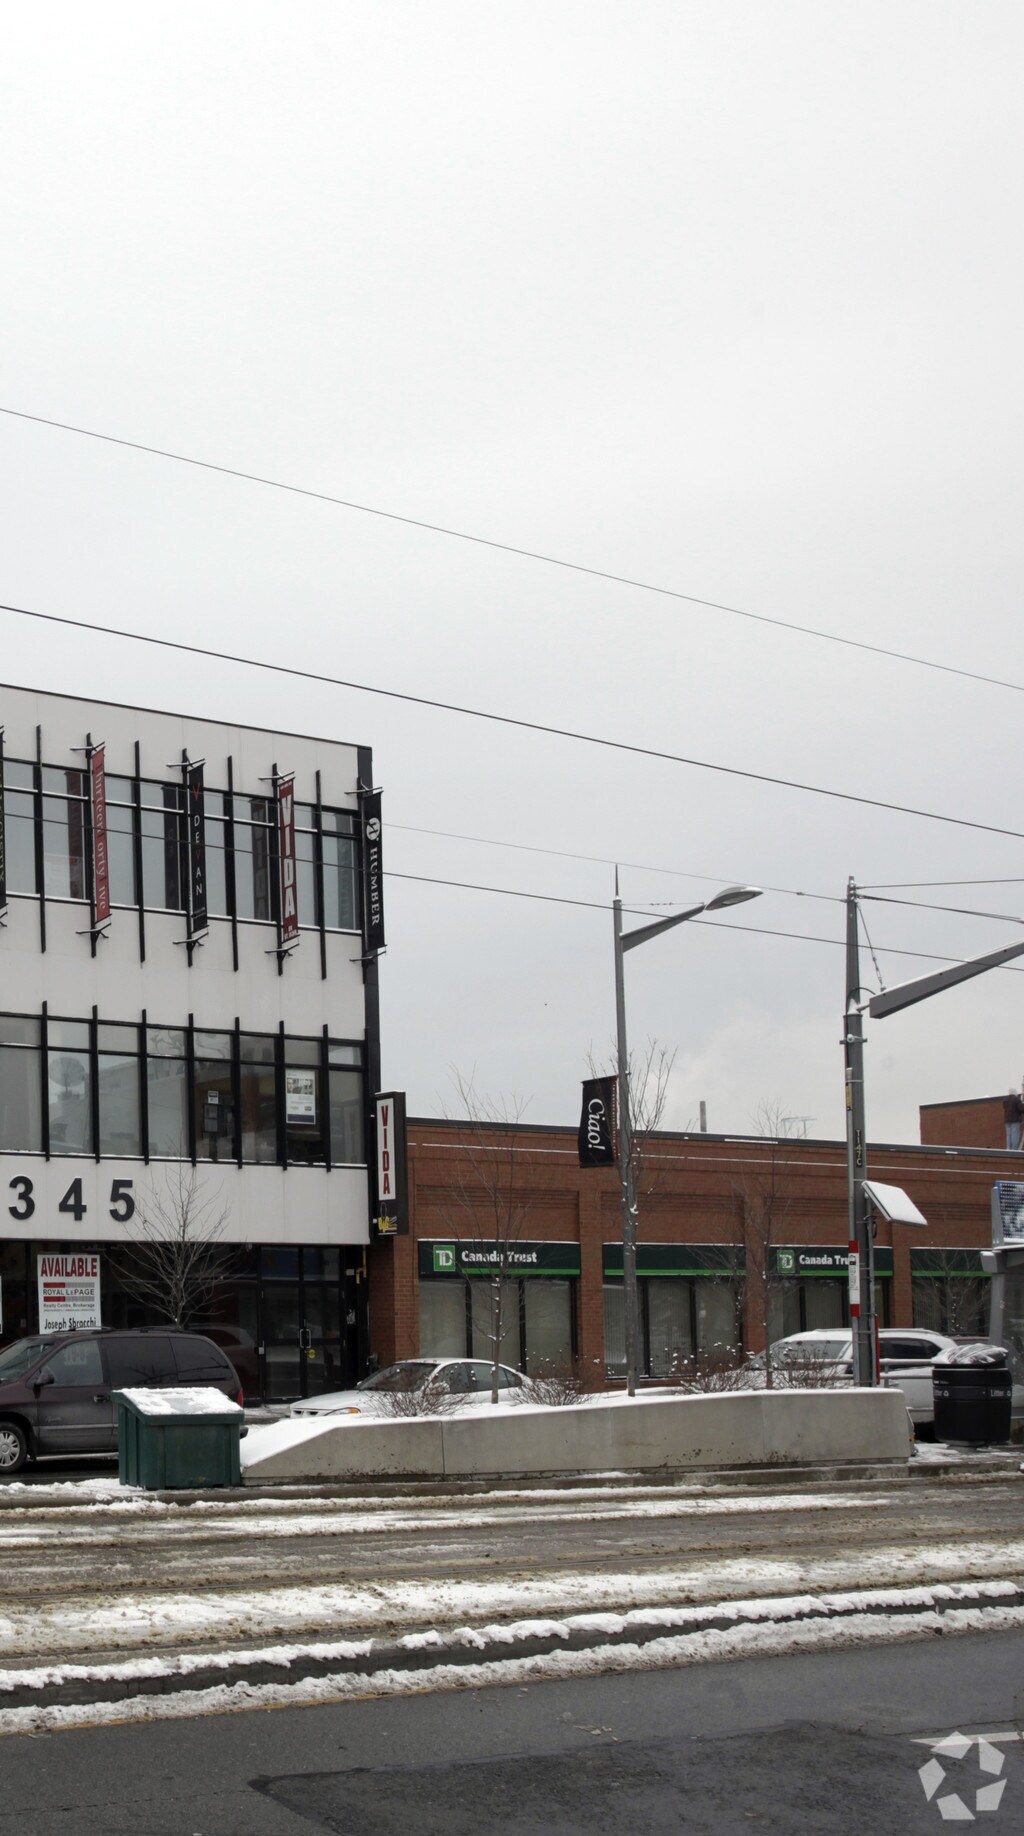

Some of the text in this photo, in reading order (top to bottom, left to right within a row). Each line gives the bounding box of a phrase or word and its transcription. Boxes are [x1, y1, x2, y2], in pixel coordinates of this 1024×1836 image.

[281, 794, 295, 918] VIDA
[370, 847, 380, 926] HUMBER
[588, 1098, 606, 1150] Ciao!
[380, 1105, 391, 1195] VIDA
[461, 1250, 503, 1263] Canada
[507, 1251, 537, 1263] Trust
[799, 1254, 833, 1265] Canada
[834, 1255, 850, 1265] Tru
[41, 1257, 97, 1278] AVAILABLE
[43, 1288, 64, 1296] ROYAL
[44, 1317, 67, 1330] Joseph
